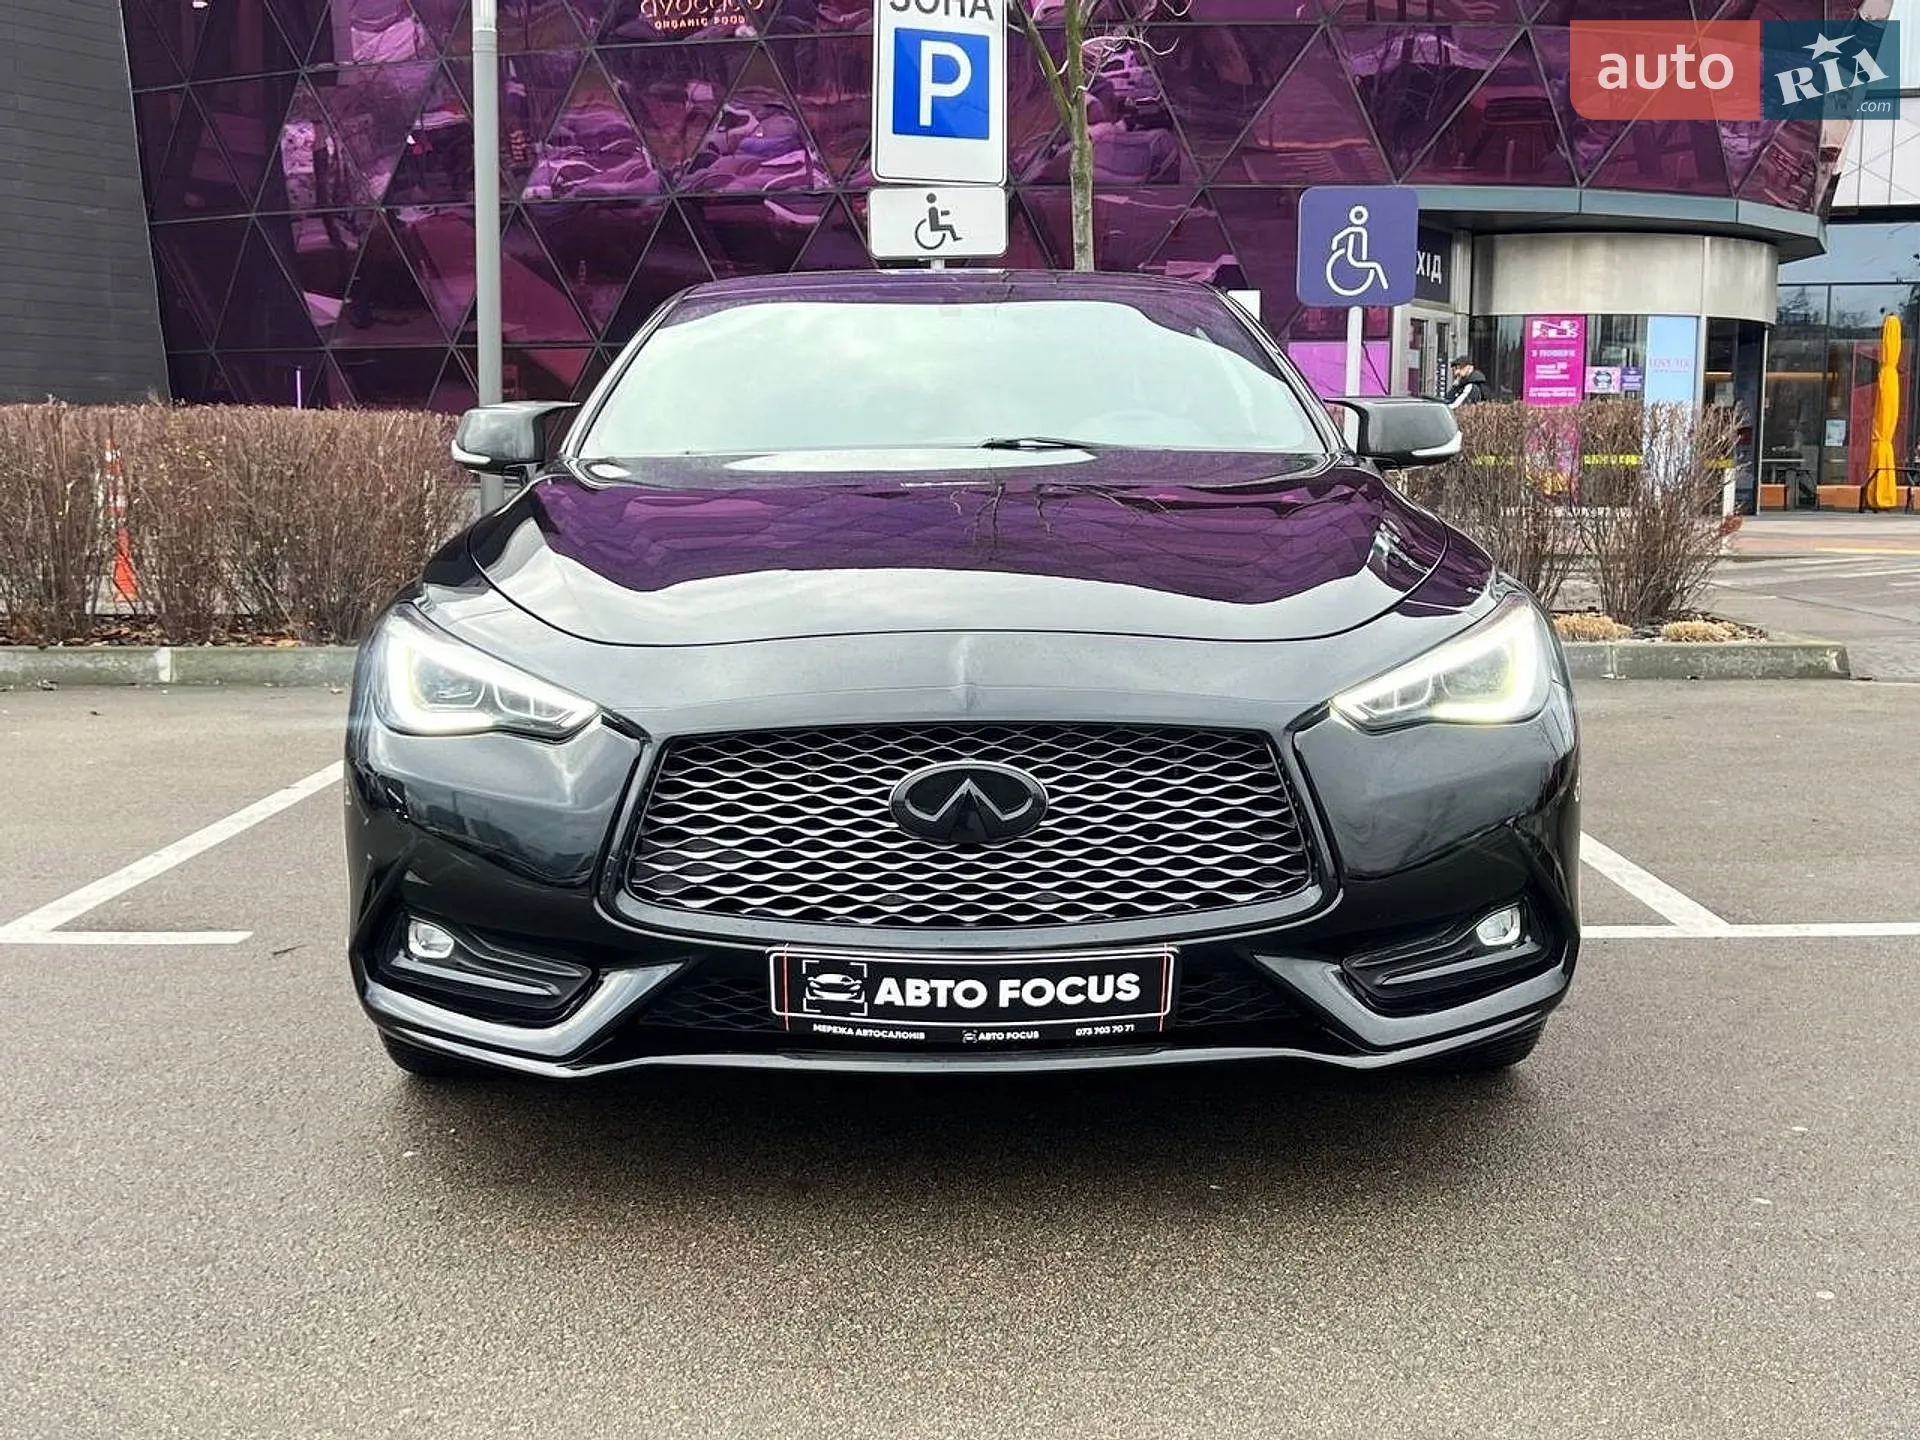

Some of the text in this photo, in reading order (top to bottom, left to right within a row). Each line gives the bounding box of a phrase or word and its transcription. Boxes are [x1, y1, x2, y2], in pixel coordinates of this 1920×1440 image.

[654, 15, 746, 30] ORGANIC FOOD
[919, 39, 972, 127] P
[1416, 250, 1442, 284] ХІД
[873, 971, 1141, 1009] АВТО FOCUS
[812, 1023, 926, 1040] МЕРЕЖА АВТОСАЛОНІВ
[978, 1030, 1040, 1041] АВТО FOCUS
[1075, 1024, 1136, 1036] 073 703 70 71
